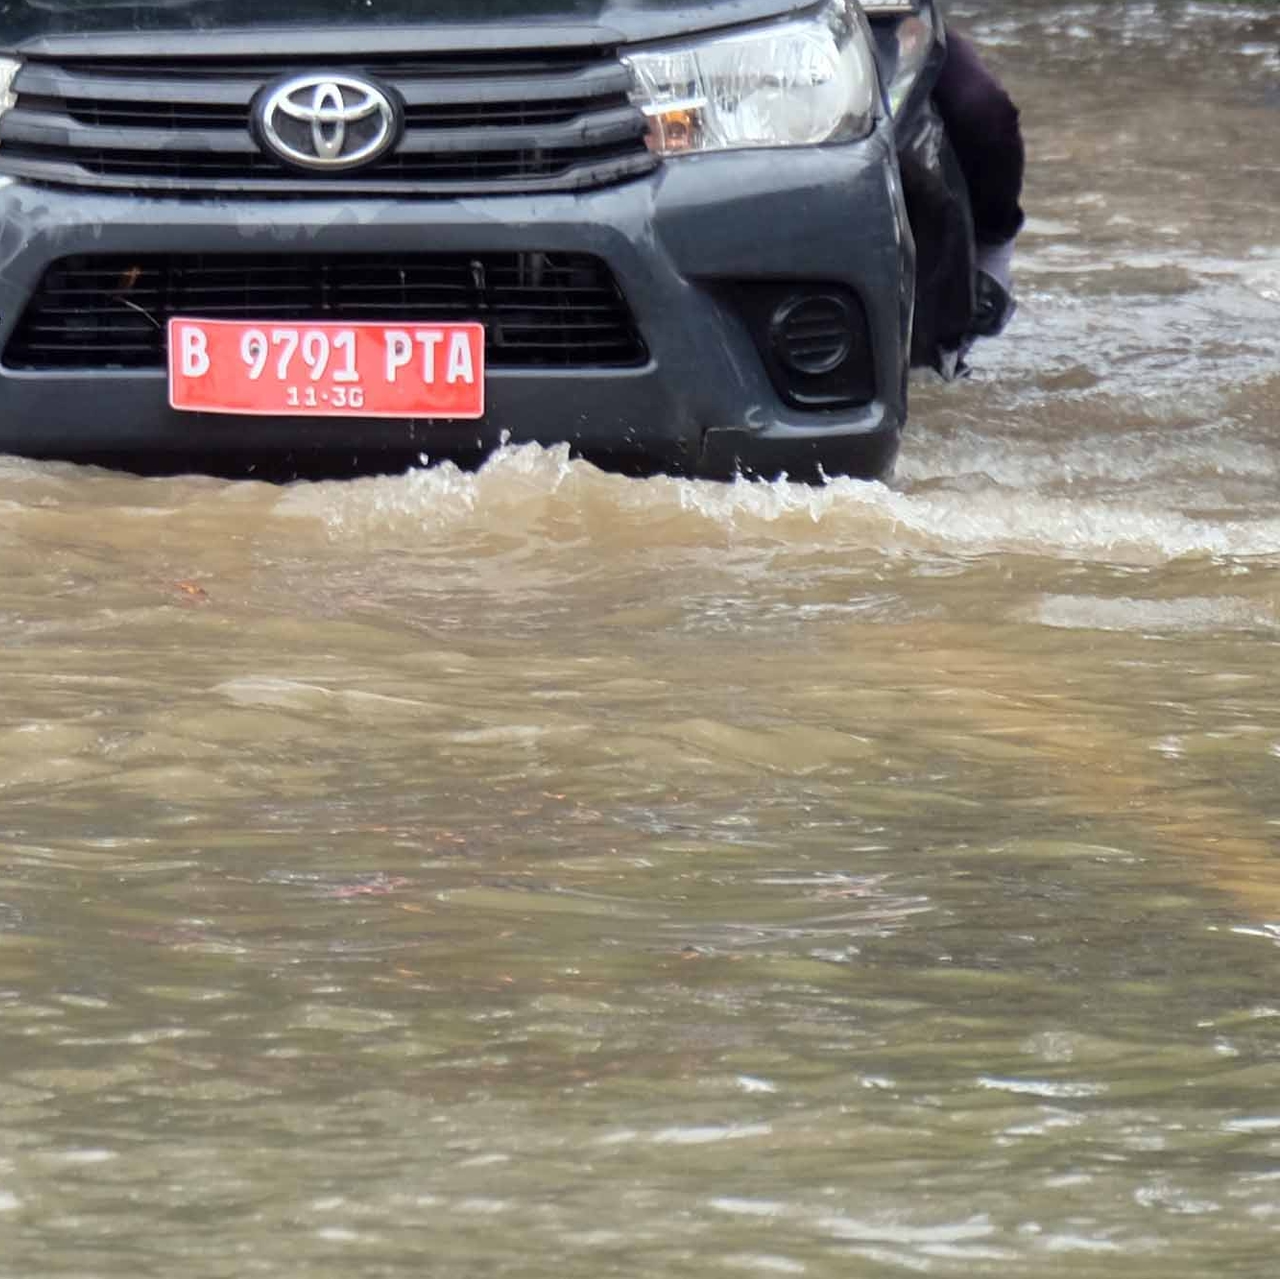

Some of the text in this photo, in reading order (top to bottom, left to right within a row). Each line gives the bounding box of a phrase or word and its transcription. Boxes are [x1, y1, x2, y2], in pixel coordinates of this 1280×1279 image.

[180, 326, 475, 384] B 9791 PTA
